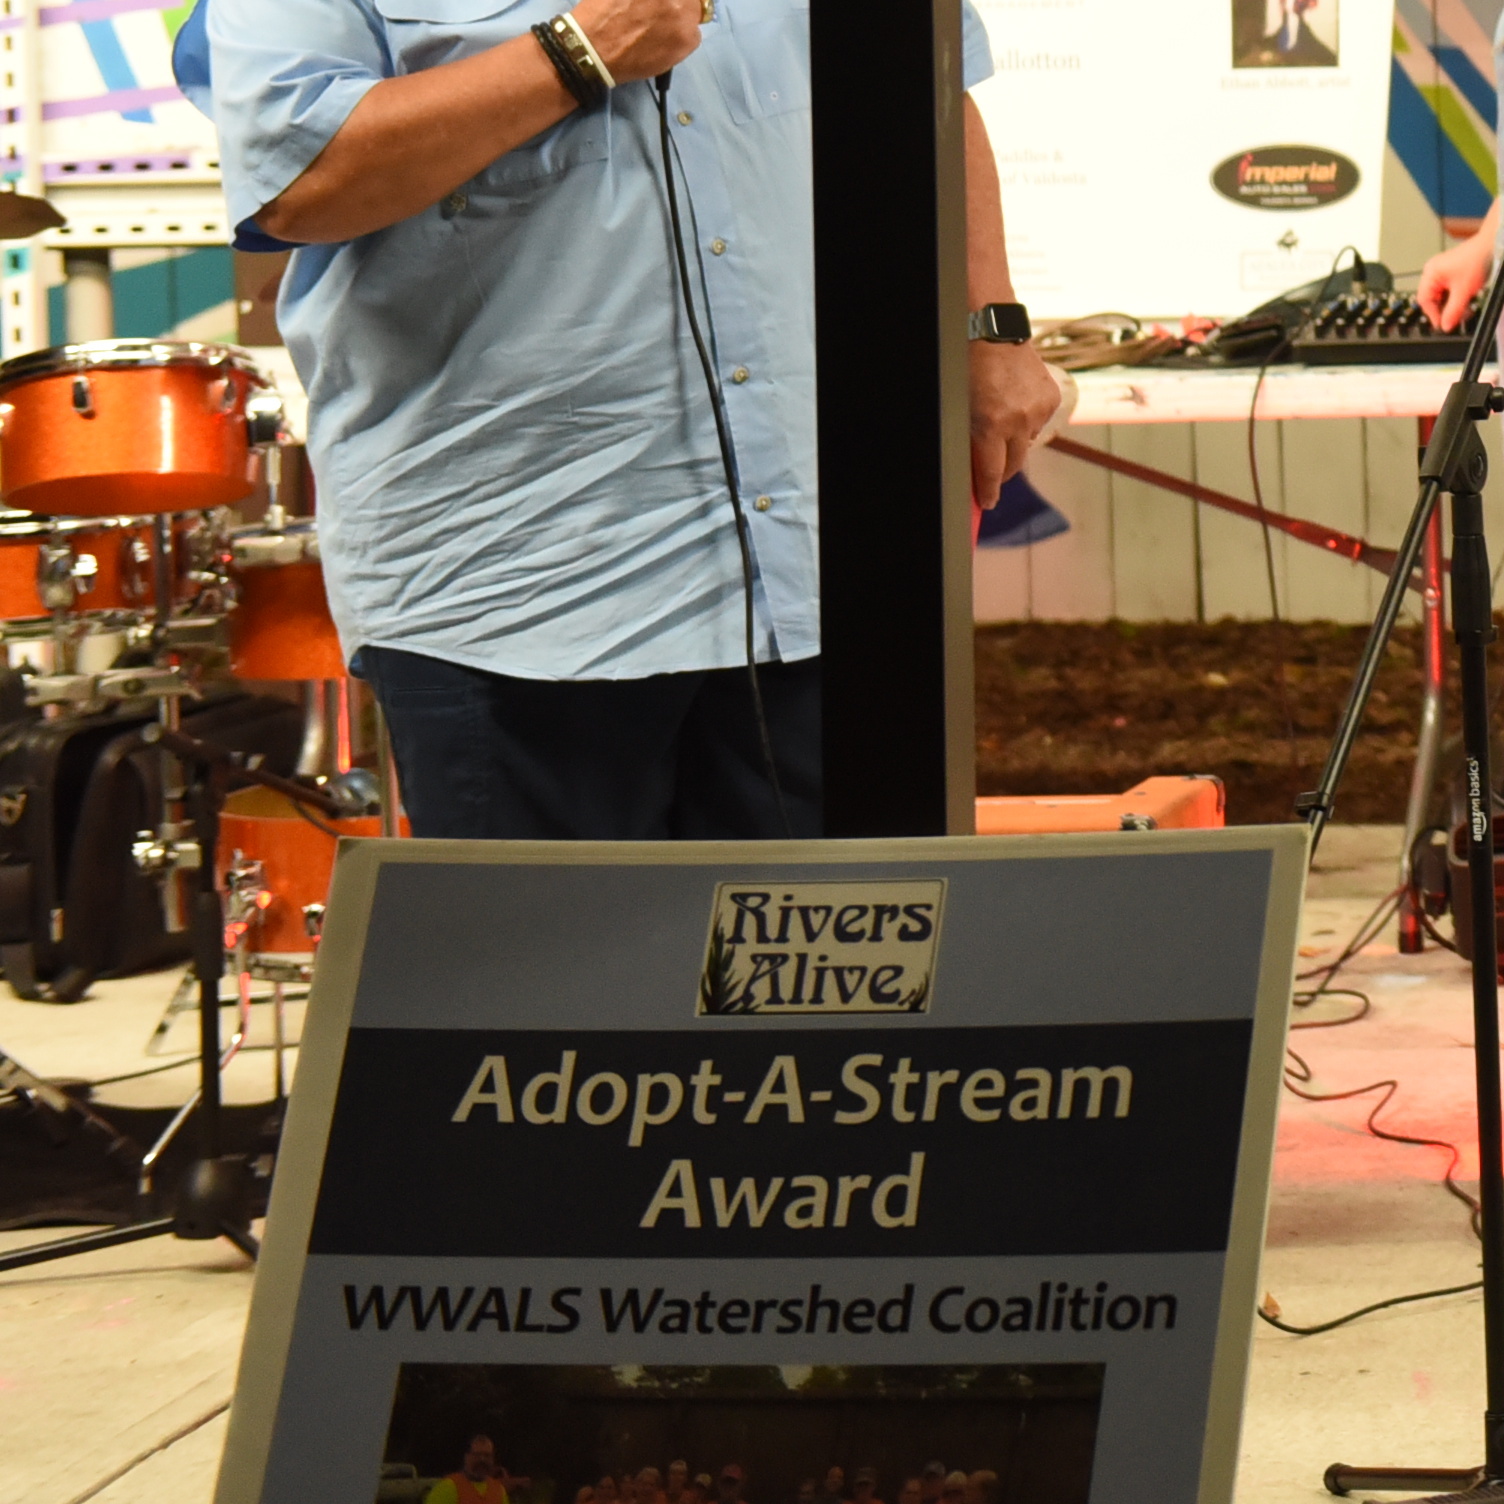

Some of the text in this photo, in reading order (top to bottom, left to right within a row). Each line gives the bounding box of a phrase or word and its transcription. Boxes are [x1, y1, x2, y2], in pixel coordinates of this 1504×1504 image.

[994, 48, 1081, 71] allotton
[1468, 760, 1484, 842] amazon basics
[725, 892, 934, 944] Rivers
[741, 953, 905, 1006] Alive
[451, 1049, 1133, 1148] Adopt-A-Stream
[638, 1152, 926, 1229] Award
[342, 1281, 1178, 1335] WWALS Watershed Coalition
